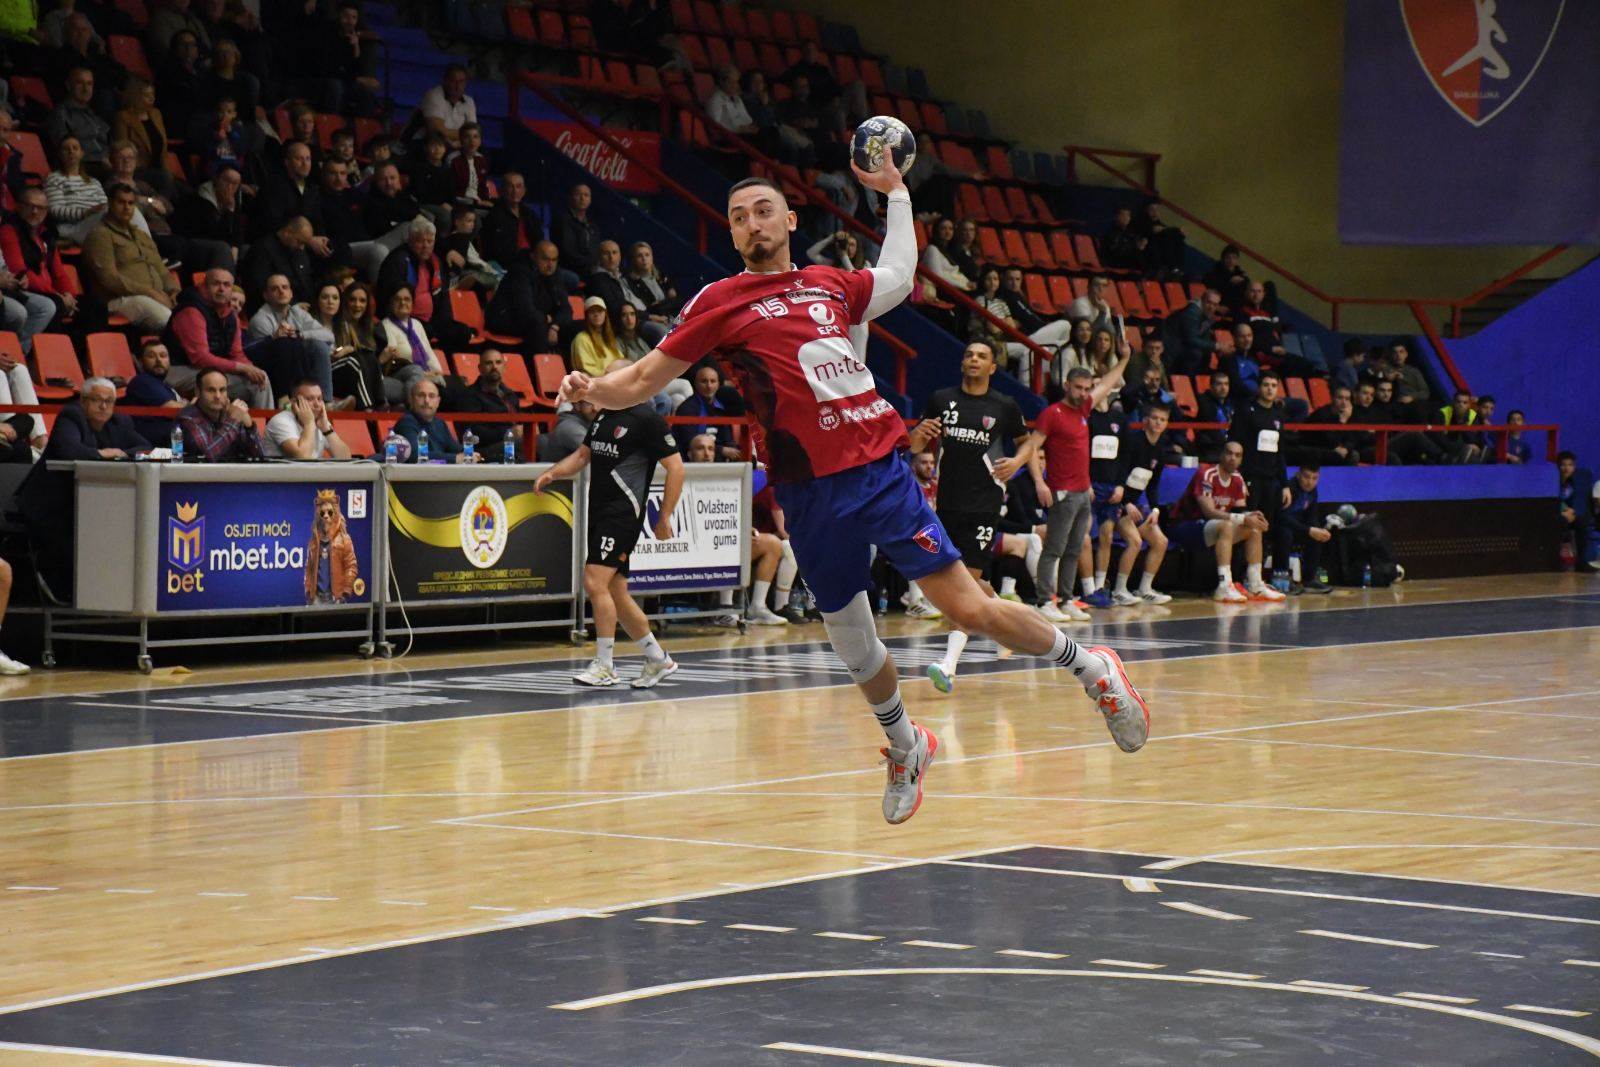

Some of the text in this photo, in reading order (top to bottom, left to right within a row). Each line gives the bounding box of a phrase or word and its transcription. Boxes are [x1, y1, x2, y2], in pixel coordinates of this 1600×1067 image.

[751, 297, 788, 320] 15
[942, 410, 959, 425] 23
[697, 499, 738, 515] Ovlašteni
[224, 520, 291, 538] OSJETI MOĆ!
[704, 517, 738, 531] uvoznik
[976, 525, 994, 542] 23
[600, 536, 616, 552] 13
[654, 541, 690, 553] MERKUR
[713, 534, 737, 550] guma
[209, 540, 304, 571] mbet.ba
[167, 568, 205, 594] bet
